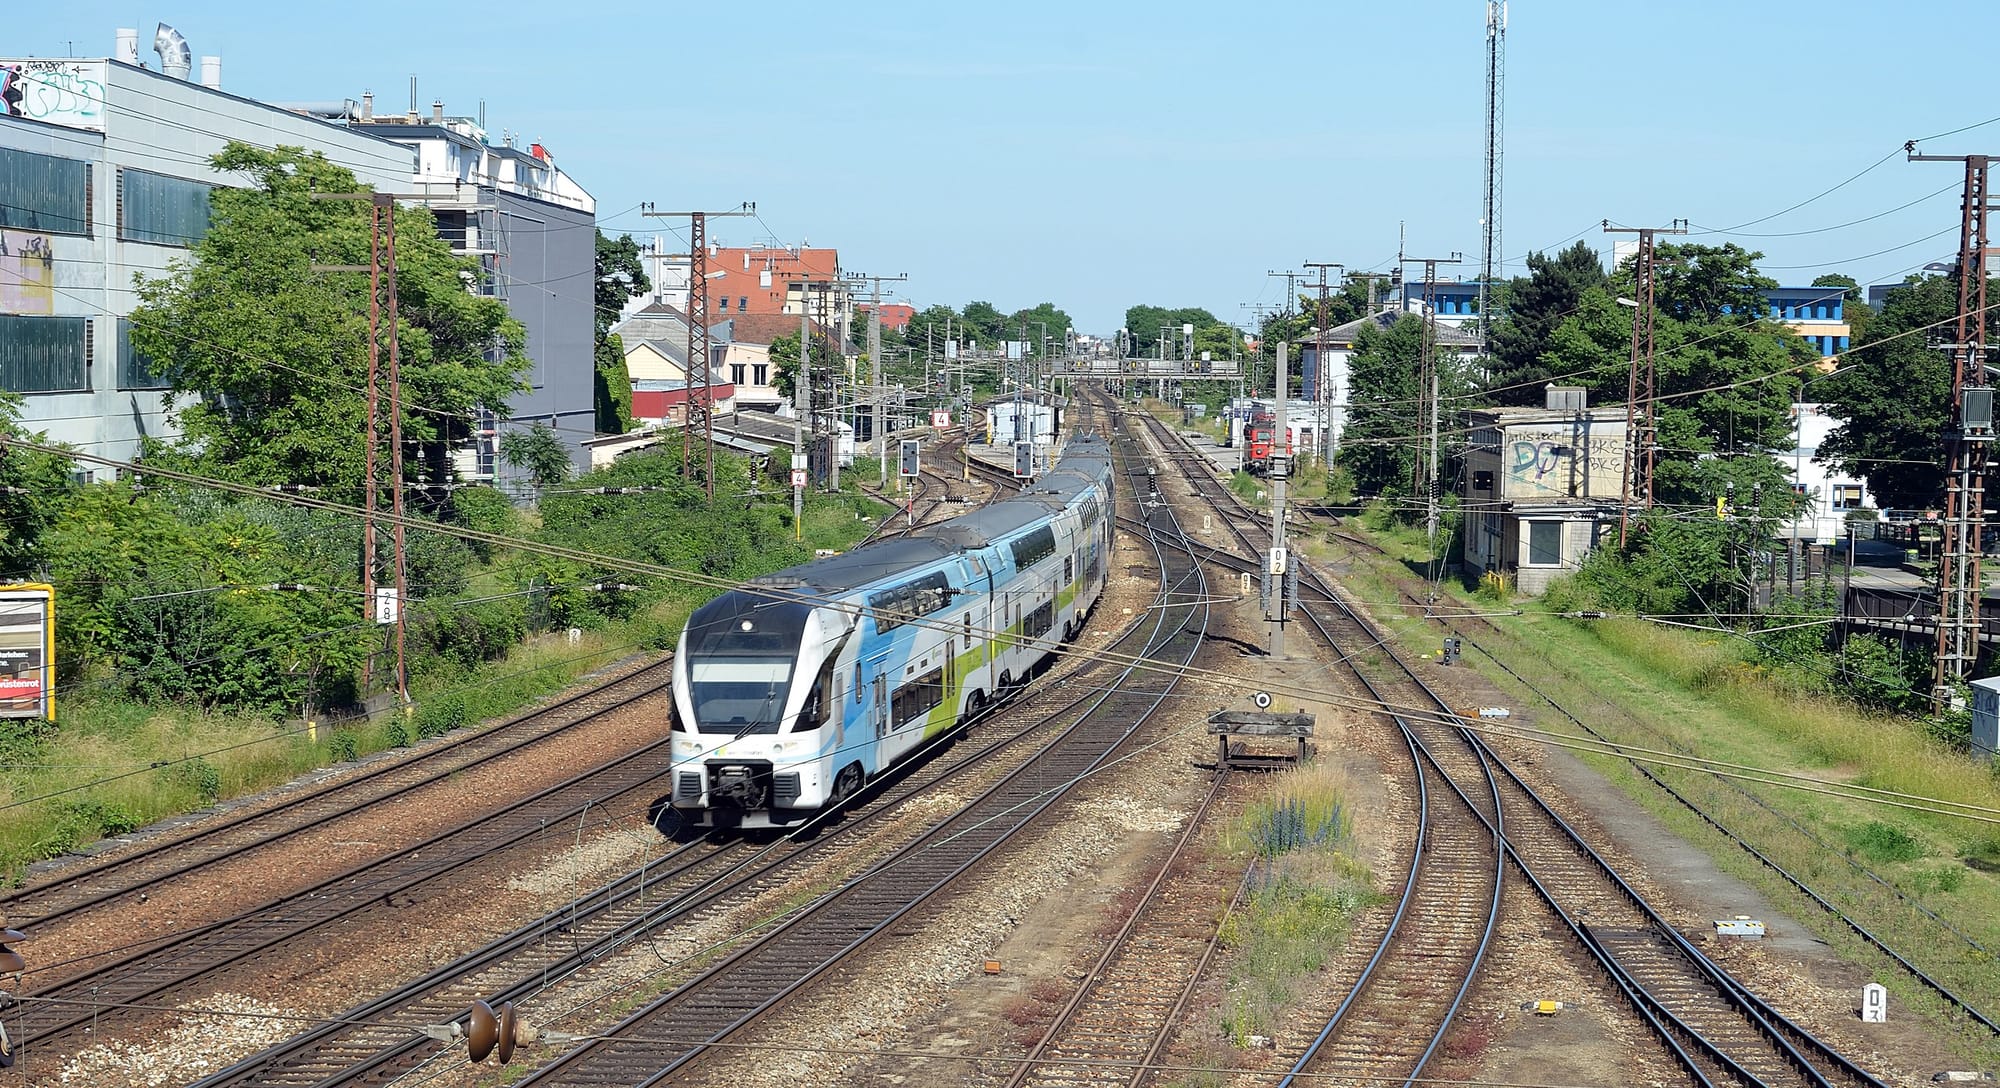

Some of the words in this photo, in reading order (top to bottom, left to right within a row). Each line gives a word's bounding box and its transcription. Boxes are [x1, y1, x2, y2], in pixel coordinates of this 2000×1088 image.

[1275, 550, 1282, 561] 0
[1275, 562, 1282, 573] 2
[384, 591, 391, 605] 2
[383, 607, 391, 620] 8
[1870, 989, 1880, 1007] 0
